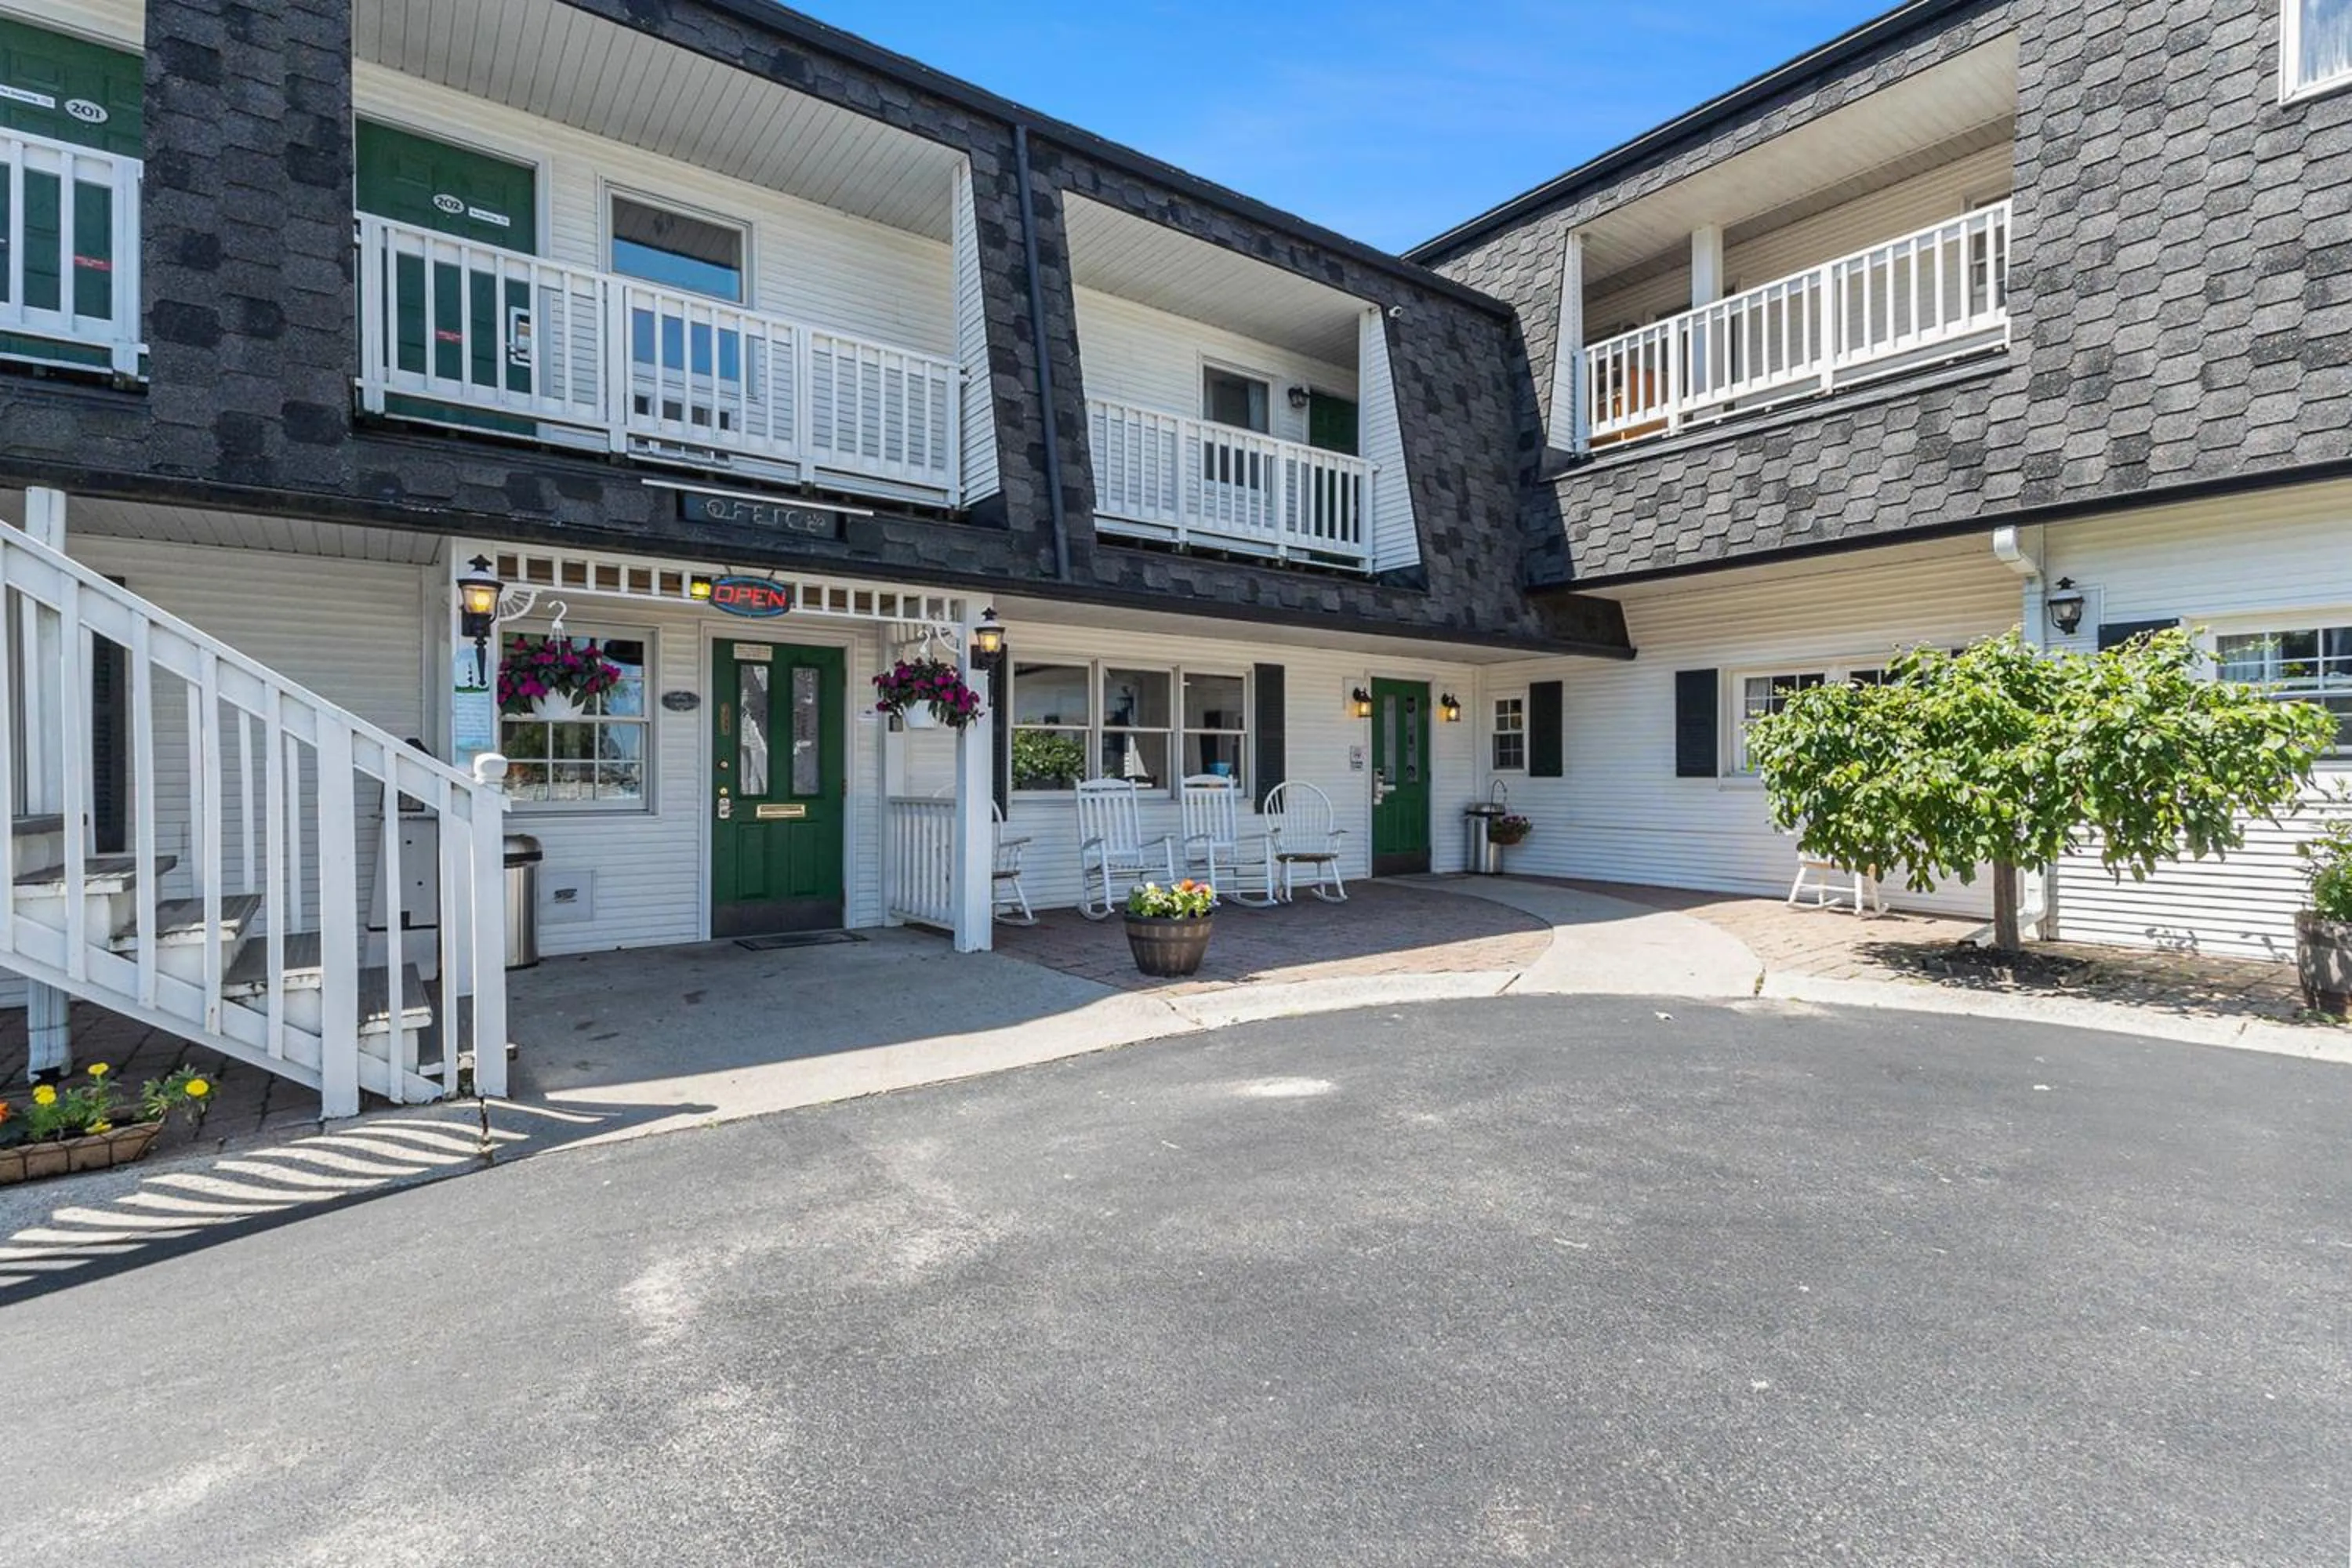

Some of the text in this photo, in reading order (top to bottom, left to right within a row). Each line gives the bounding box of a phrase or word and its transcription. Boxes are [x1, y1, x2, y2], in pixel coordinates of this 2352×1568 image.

[71, 101, 100, 119] 201
[437, 197, 462, 211] 202
[714, 585, 786, 607] OPEN
